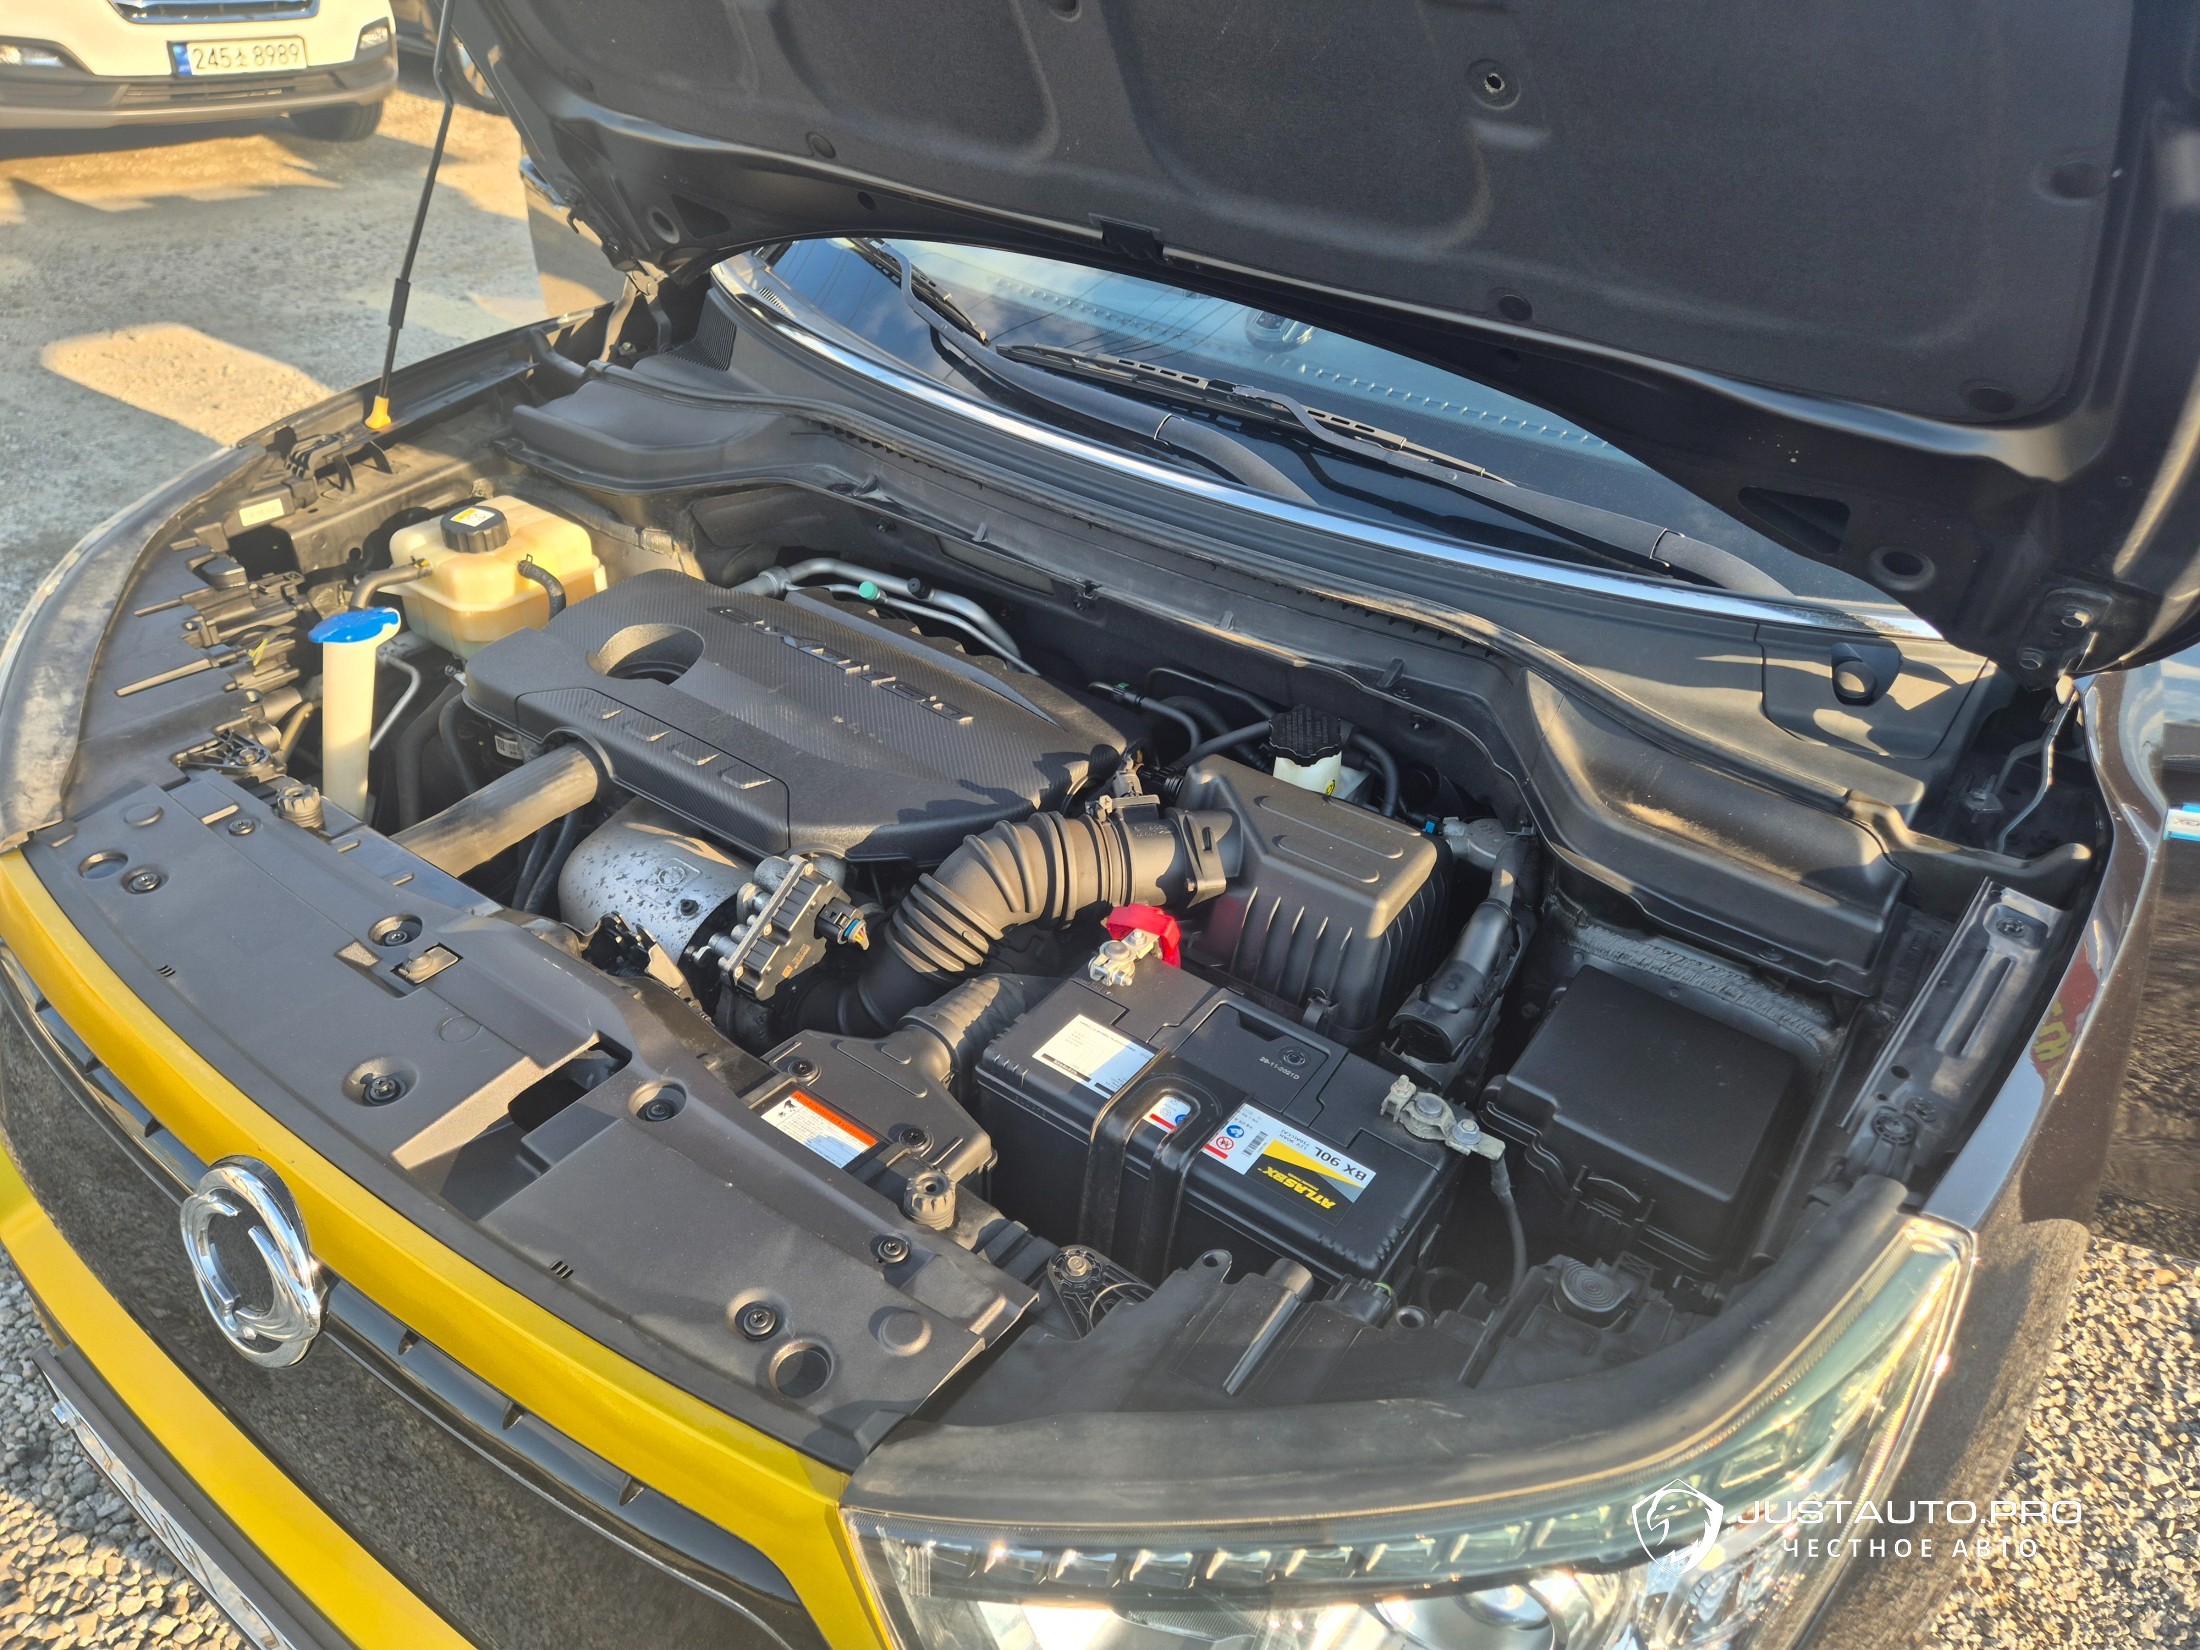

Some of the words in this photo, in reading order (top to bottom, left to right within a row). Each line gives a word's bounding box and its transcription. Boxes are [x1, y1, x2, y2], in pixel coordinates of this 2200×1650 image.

[253, 43, 299, 67] 8989
[1314, 1146, 1341, 1167] 90L
[1342, 1164, 1368, 1182] BX
[1262, 1166, 1337, 1209] ATLASBX
